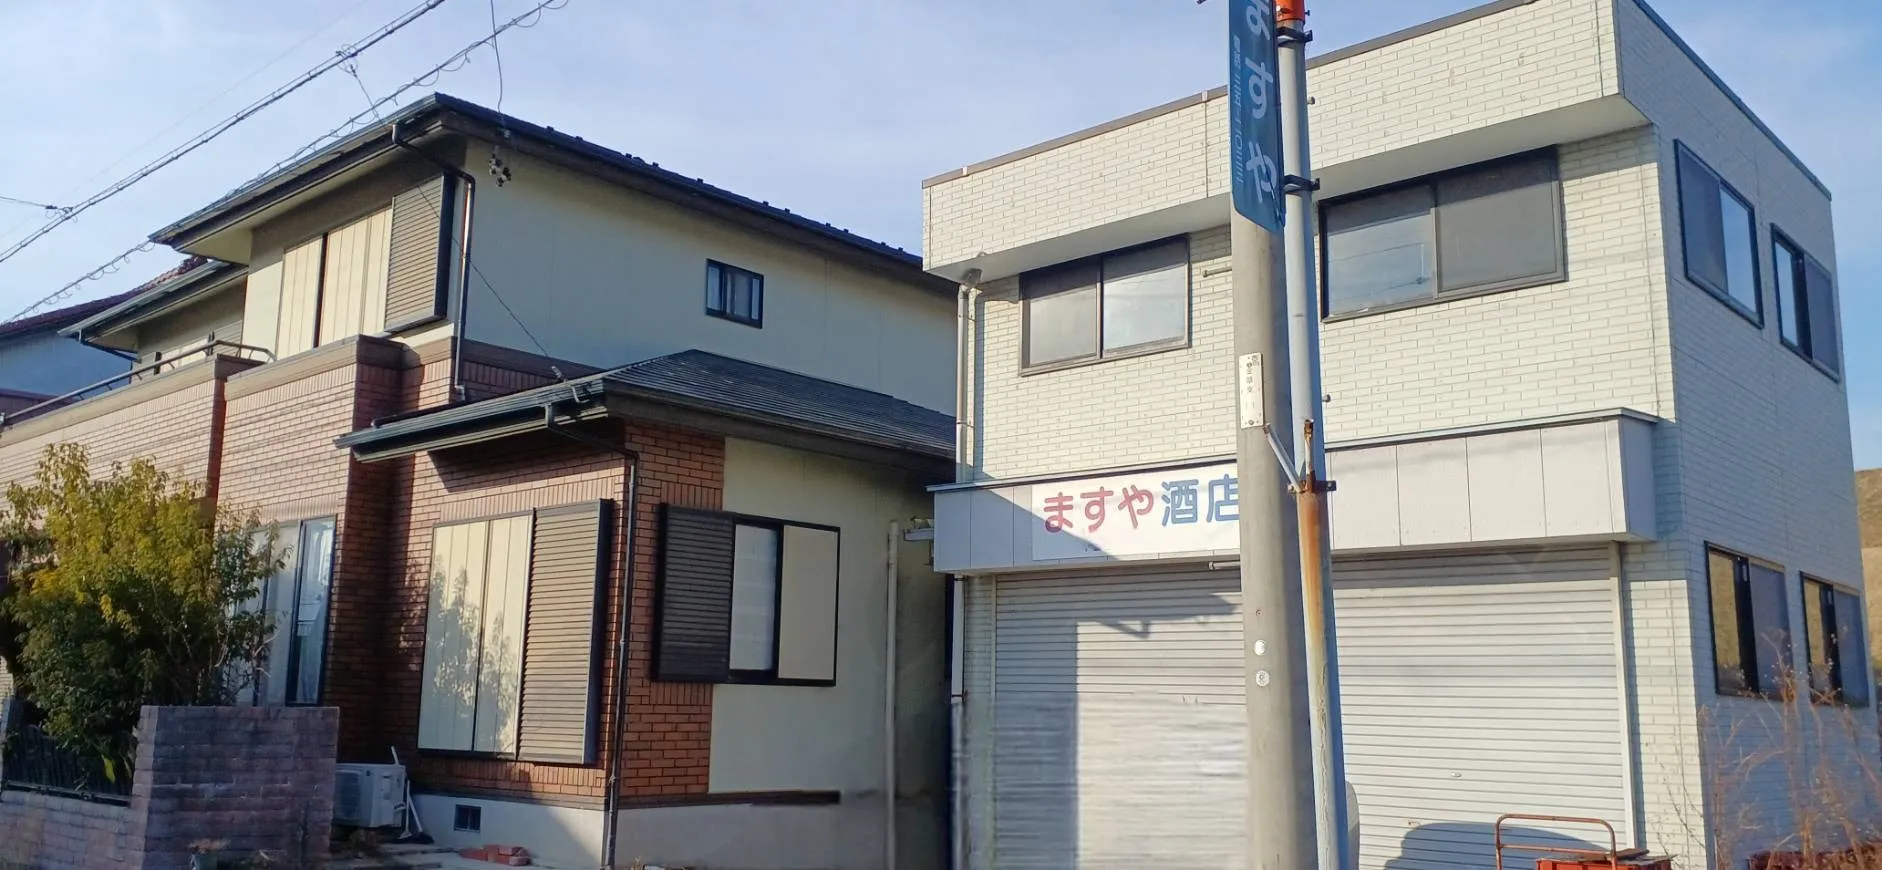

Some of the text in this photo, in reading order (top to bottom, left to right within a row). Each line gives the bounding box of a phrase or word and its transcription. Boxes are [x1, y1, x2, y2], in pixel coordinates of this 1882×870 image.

[1043, 473, 1240, 533] ますや酒店
